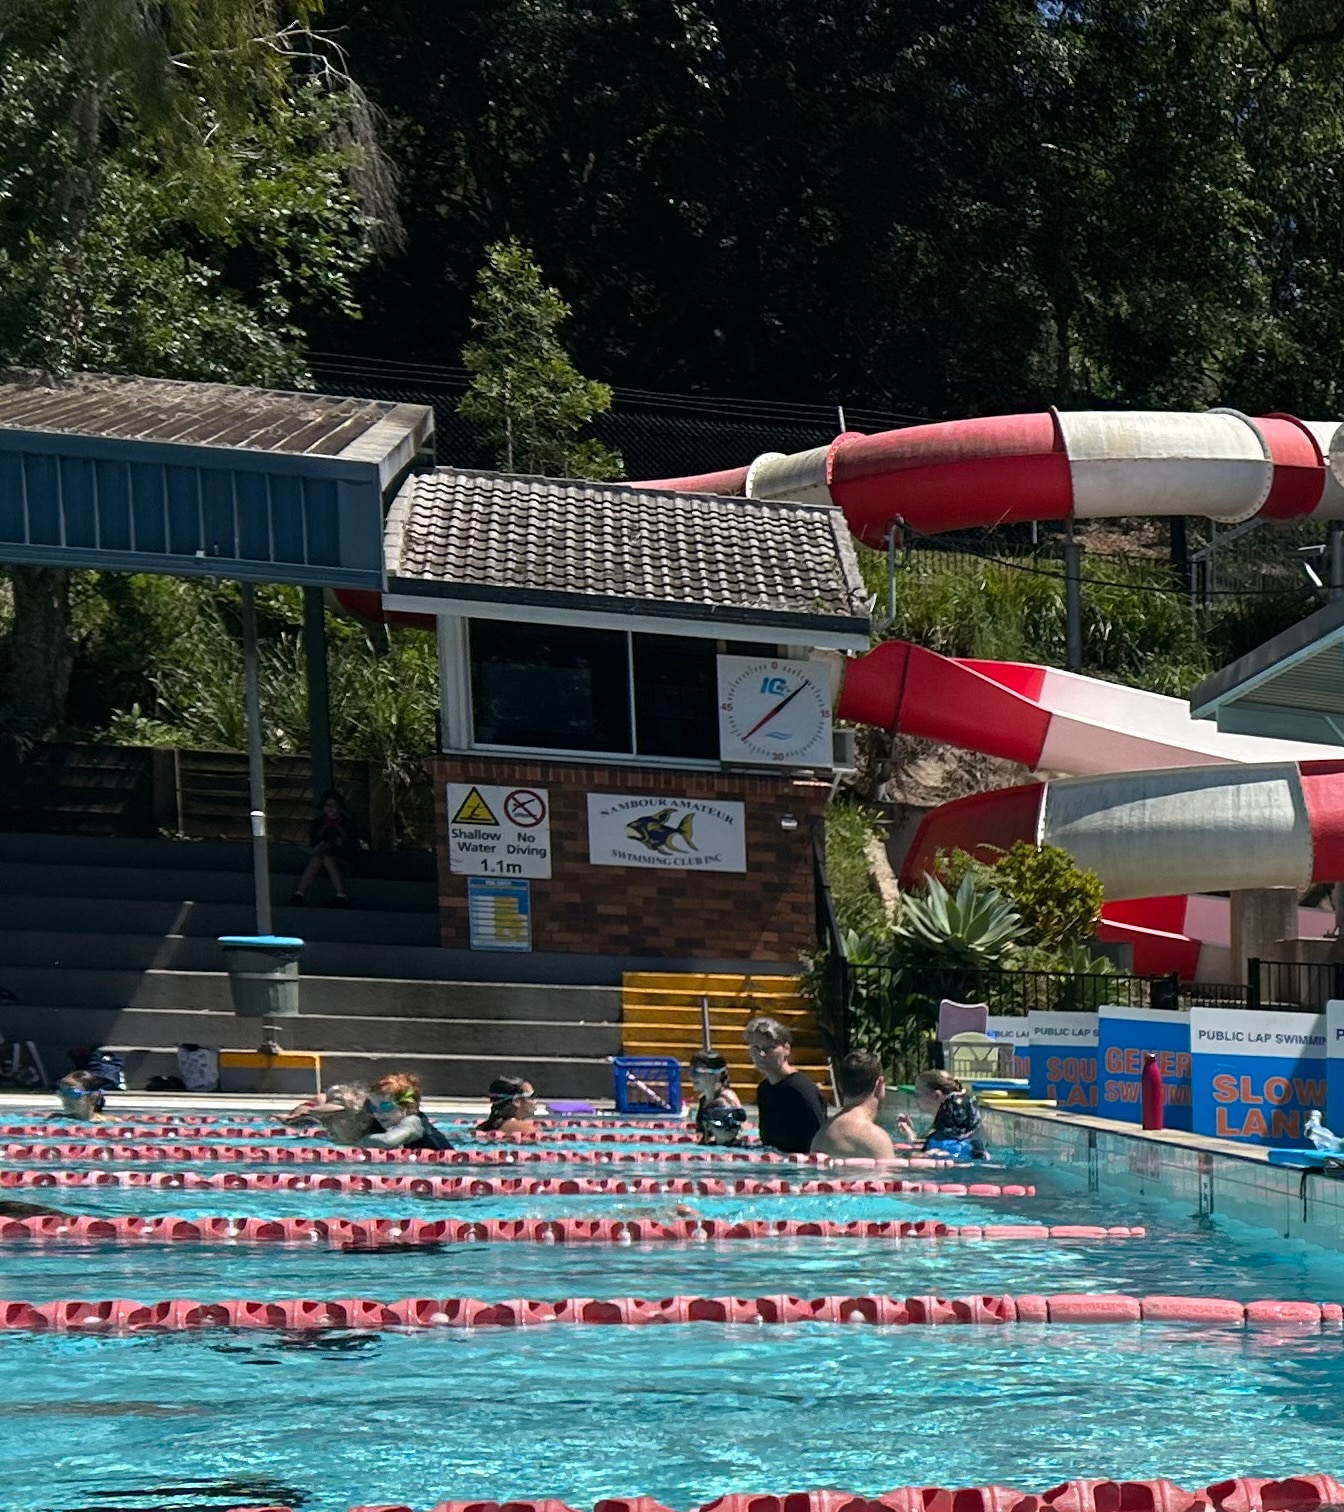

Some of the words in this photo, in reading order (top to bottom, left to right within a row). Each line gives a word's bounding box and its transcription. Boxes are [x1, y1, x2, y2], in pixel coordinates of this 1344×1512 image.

[771, 752, 785, 761] 30
[600, 799, 667, 817] NAMBOUR
[670, 799, 733, 825] AMATEUR
[451, 828, 501, 841] Shallow
[517, 832, 535, 843] No
[457, 841, 496, 853] Water
[506, 844, 547, 859] Diving
[610, 849, 672, 865] SWIMMING
[673, 854, 703, 866] CLUB
[704, 853, 723, 864] INC
[480, 858, 522, 873] 1.1m
[1034, 1027, 1069, 1036] PUBLIC
[1072, 1028, 1090, 1036] LAP
[1198, 1030, 1245, 1042] PUBLIC
[1248, 1032, 1272, 1044] LAP
[1212, 1074, 1327, 1106] SLOW
[1215, 1107, 1320, 1138] LAN
